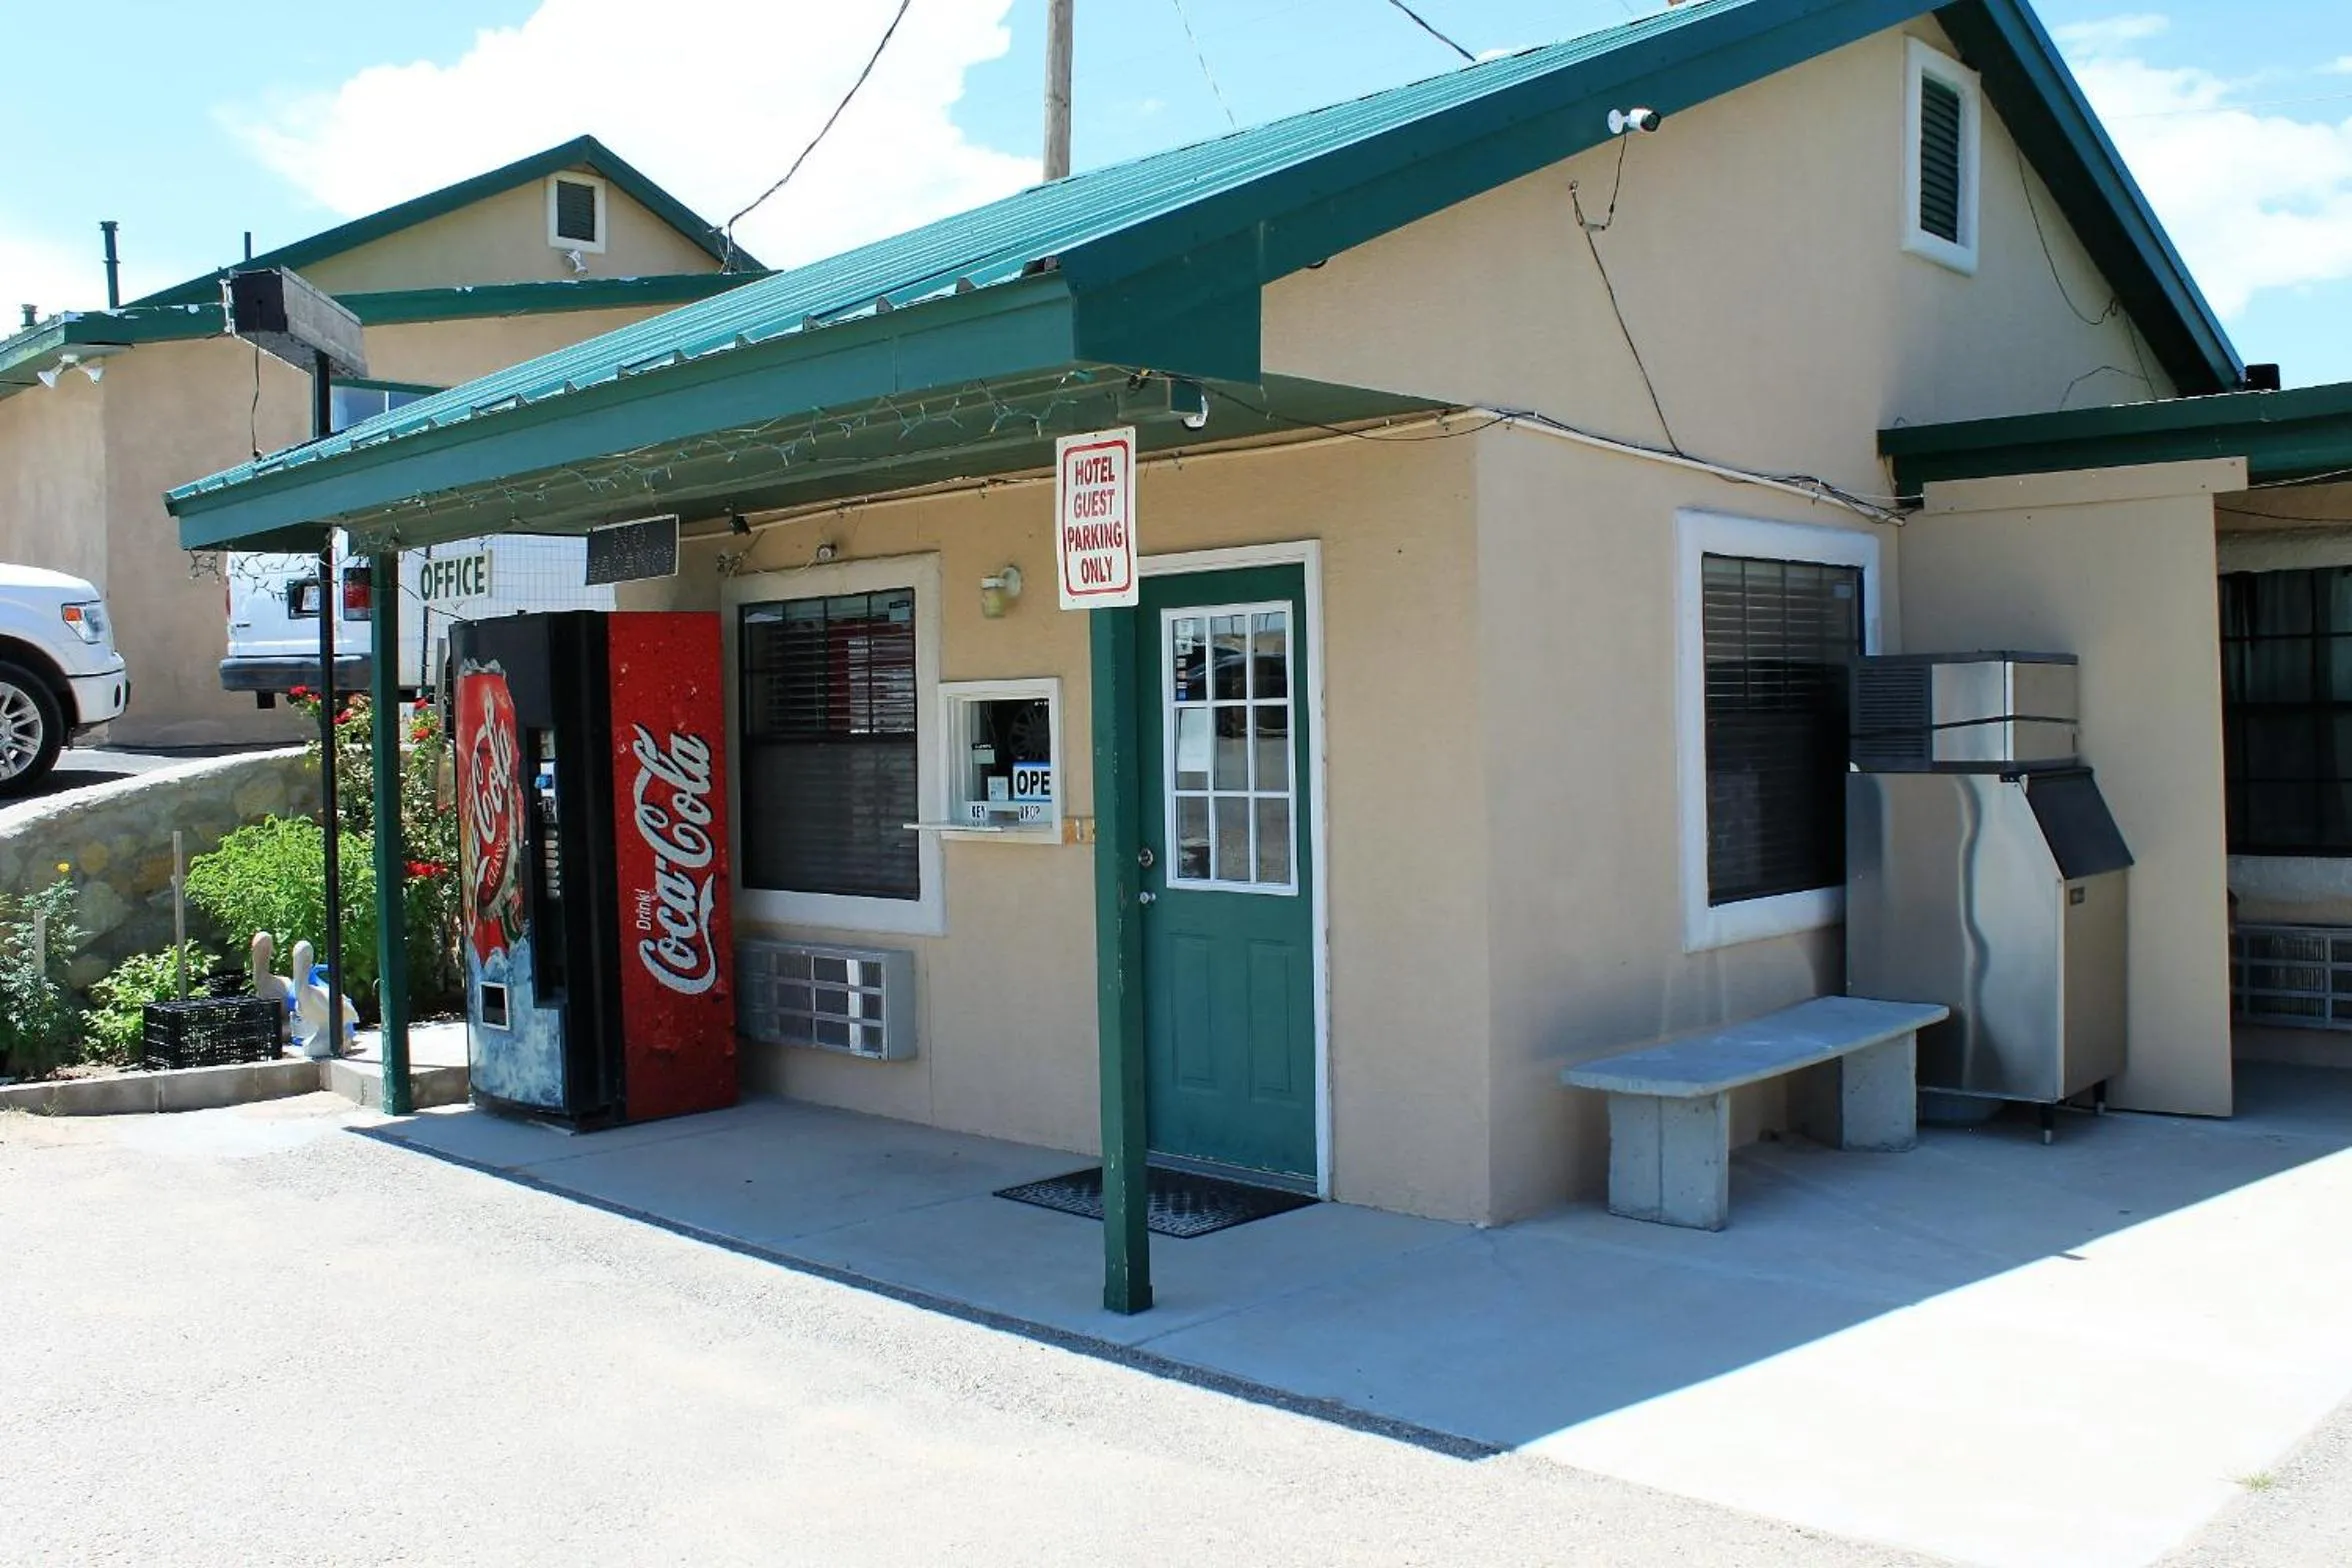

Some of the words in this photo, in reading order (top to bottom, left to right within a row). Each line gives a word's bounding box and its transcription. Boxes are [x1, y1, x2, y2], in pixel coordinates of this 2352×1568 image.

[1075, 456, 1115, 486] HOTEL
[1074, 489, 1116, 519] GUEST
[1067, 521, 1122, 552] PARKING
[421, 555, 485, 600] OFFICE
[1081, 556, 1113, 584] ONLY
[633, 722, 717, 995] Coca-Cola
